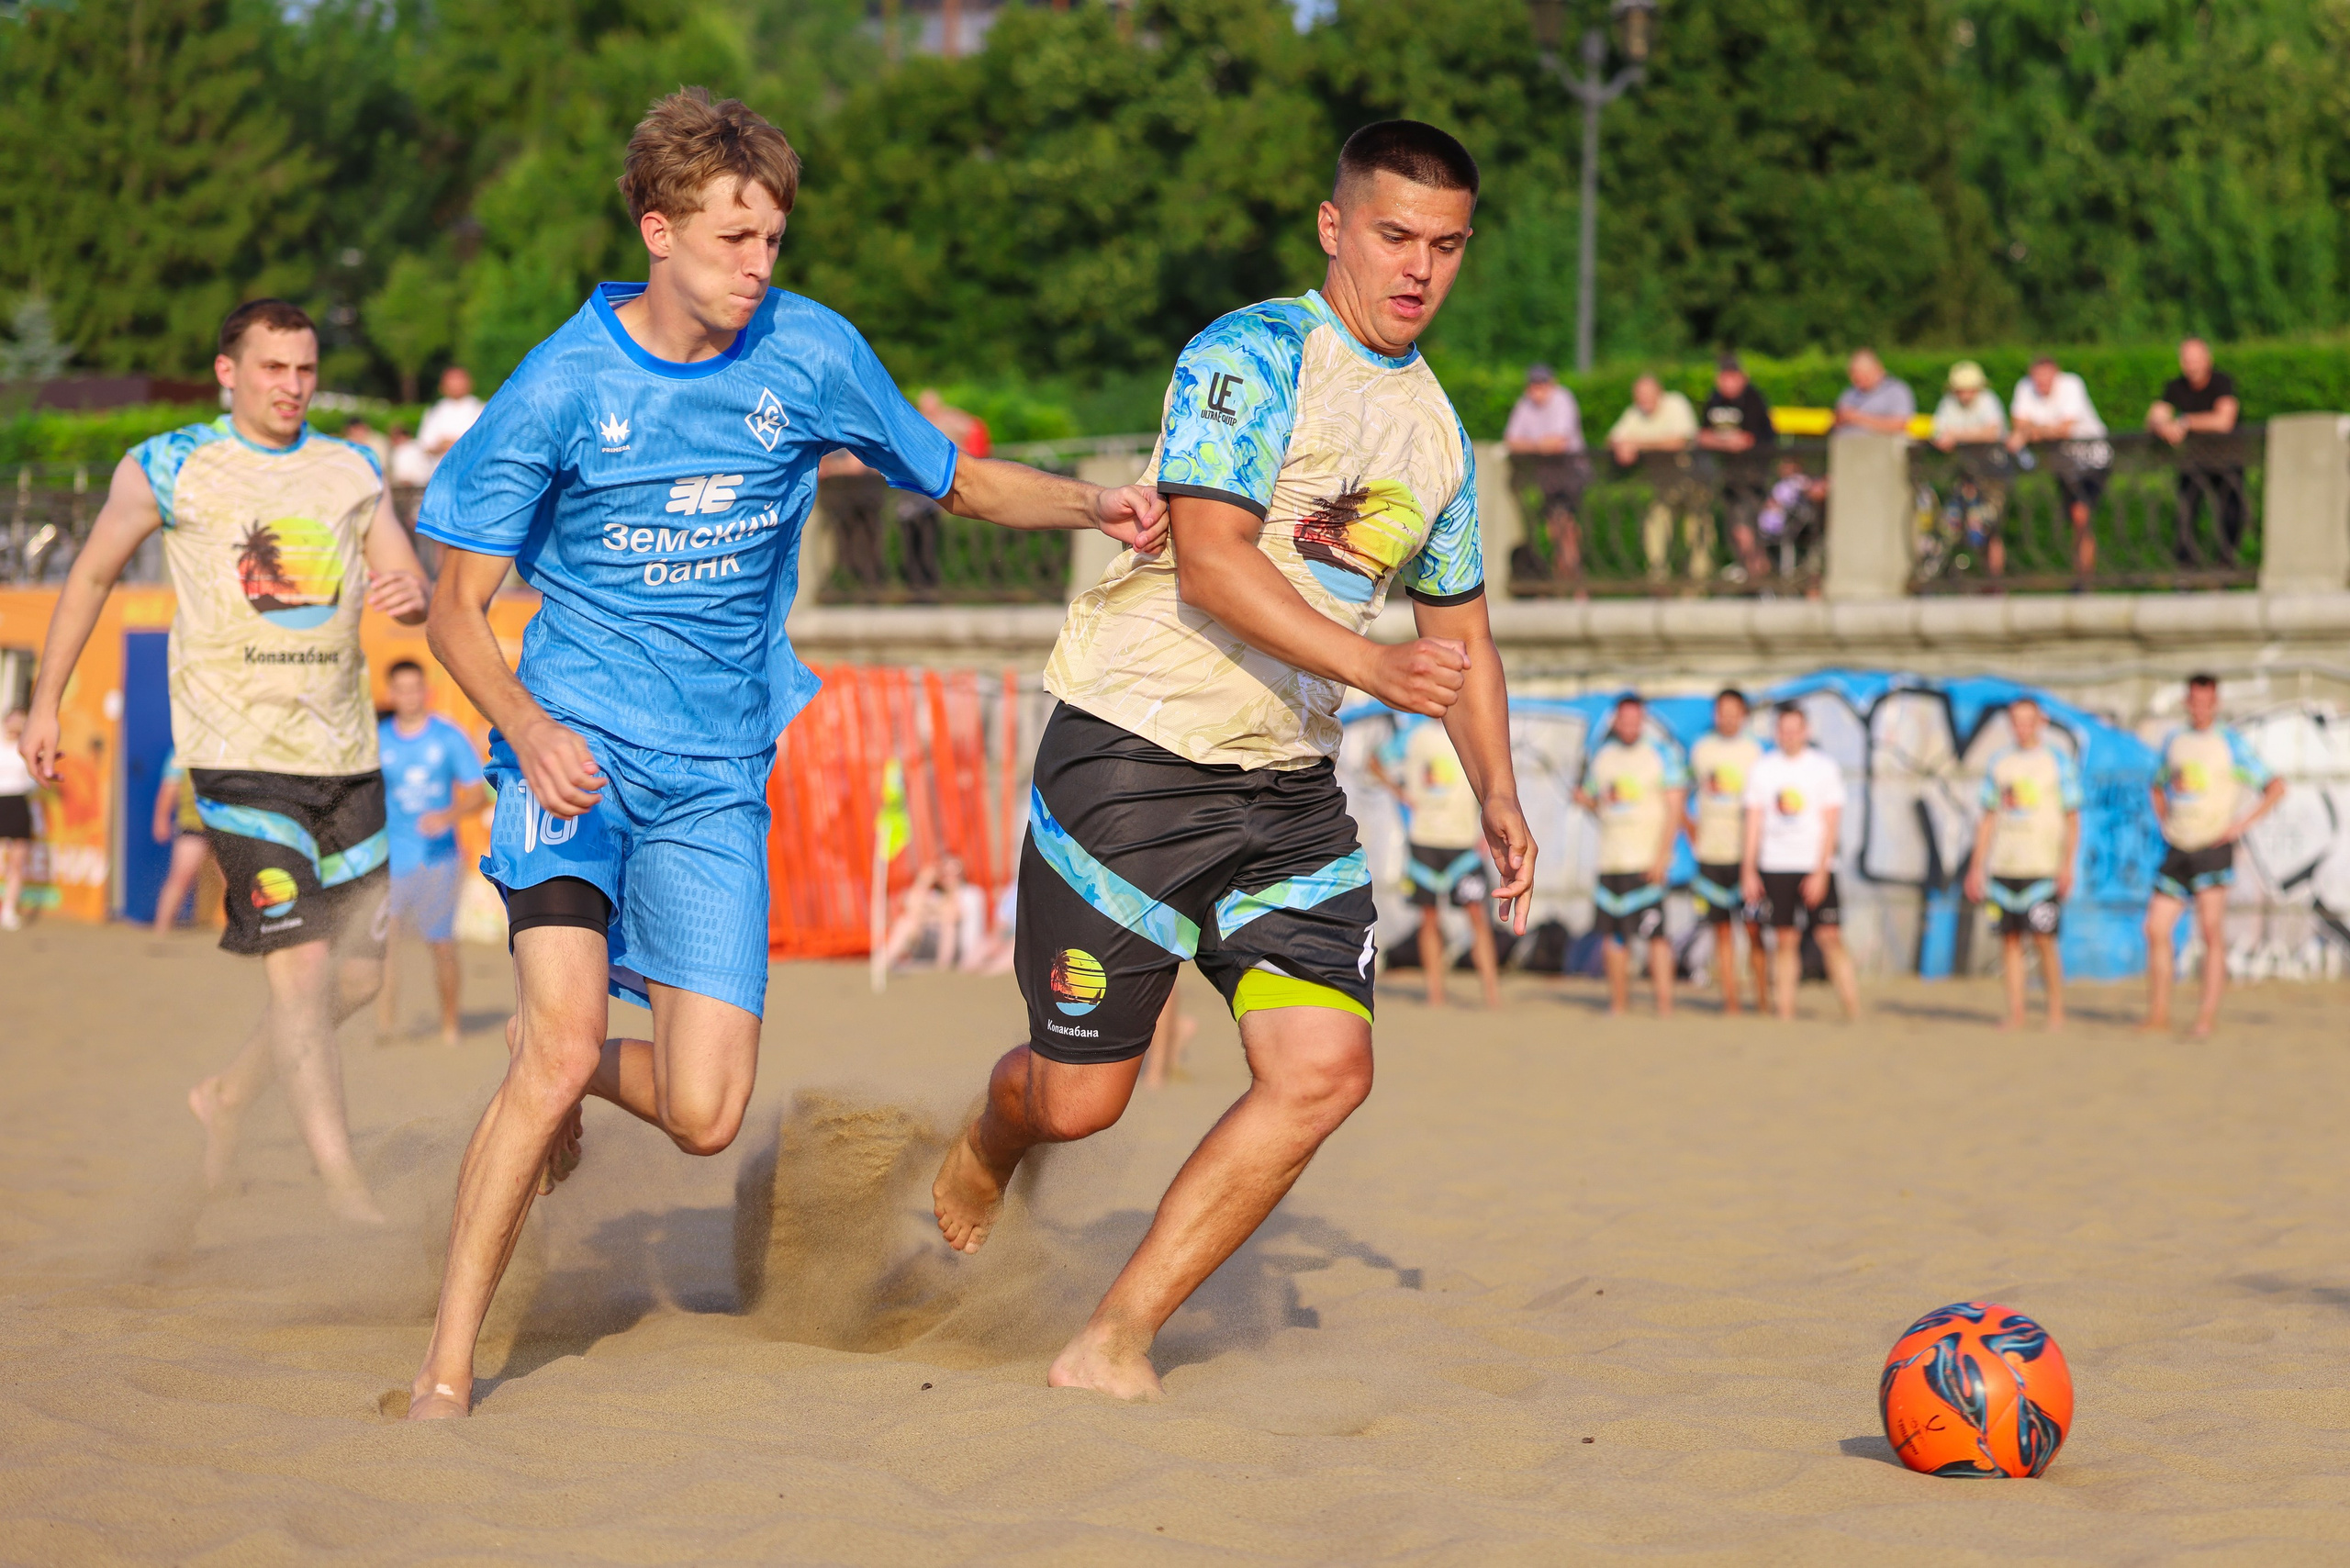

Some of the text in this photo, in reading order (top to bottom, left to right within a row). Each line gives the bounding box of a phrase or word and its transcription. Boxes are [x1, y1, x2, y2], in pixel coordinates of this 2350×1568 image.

[601, 444, 631, 453] PRIMERA
[602, 501, 778, 554] Земский
[643, 553, 741, 587] банк
[244, 646, 339, 664] Копакабана
[1046, 1019, 1099, 1037] Копакабана
